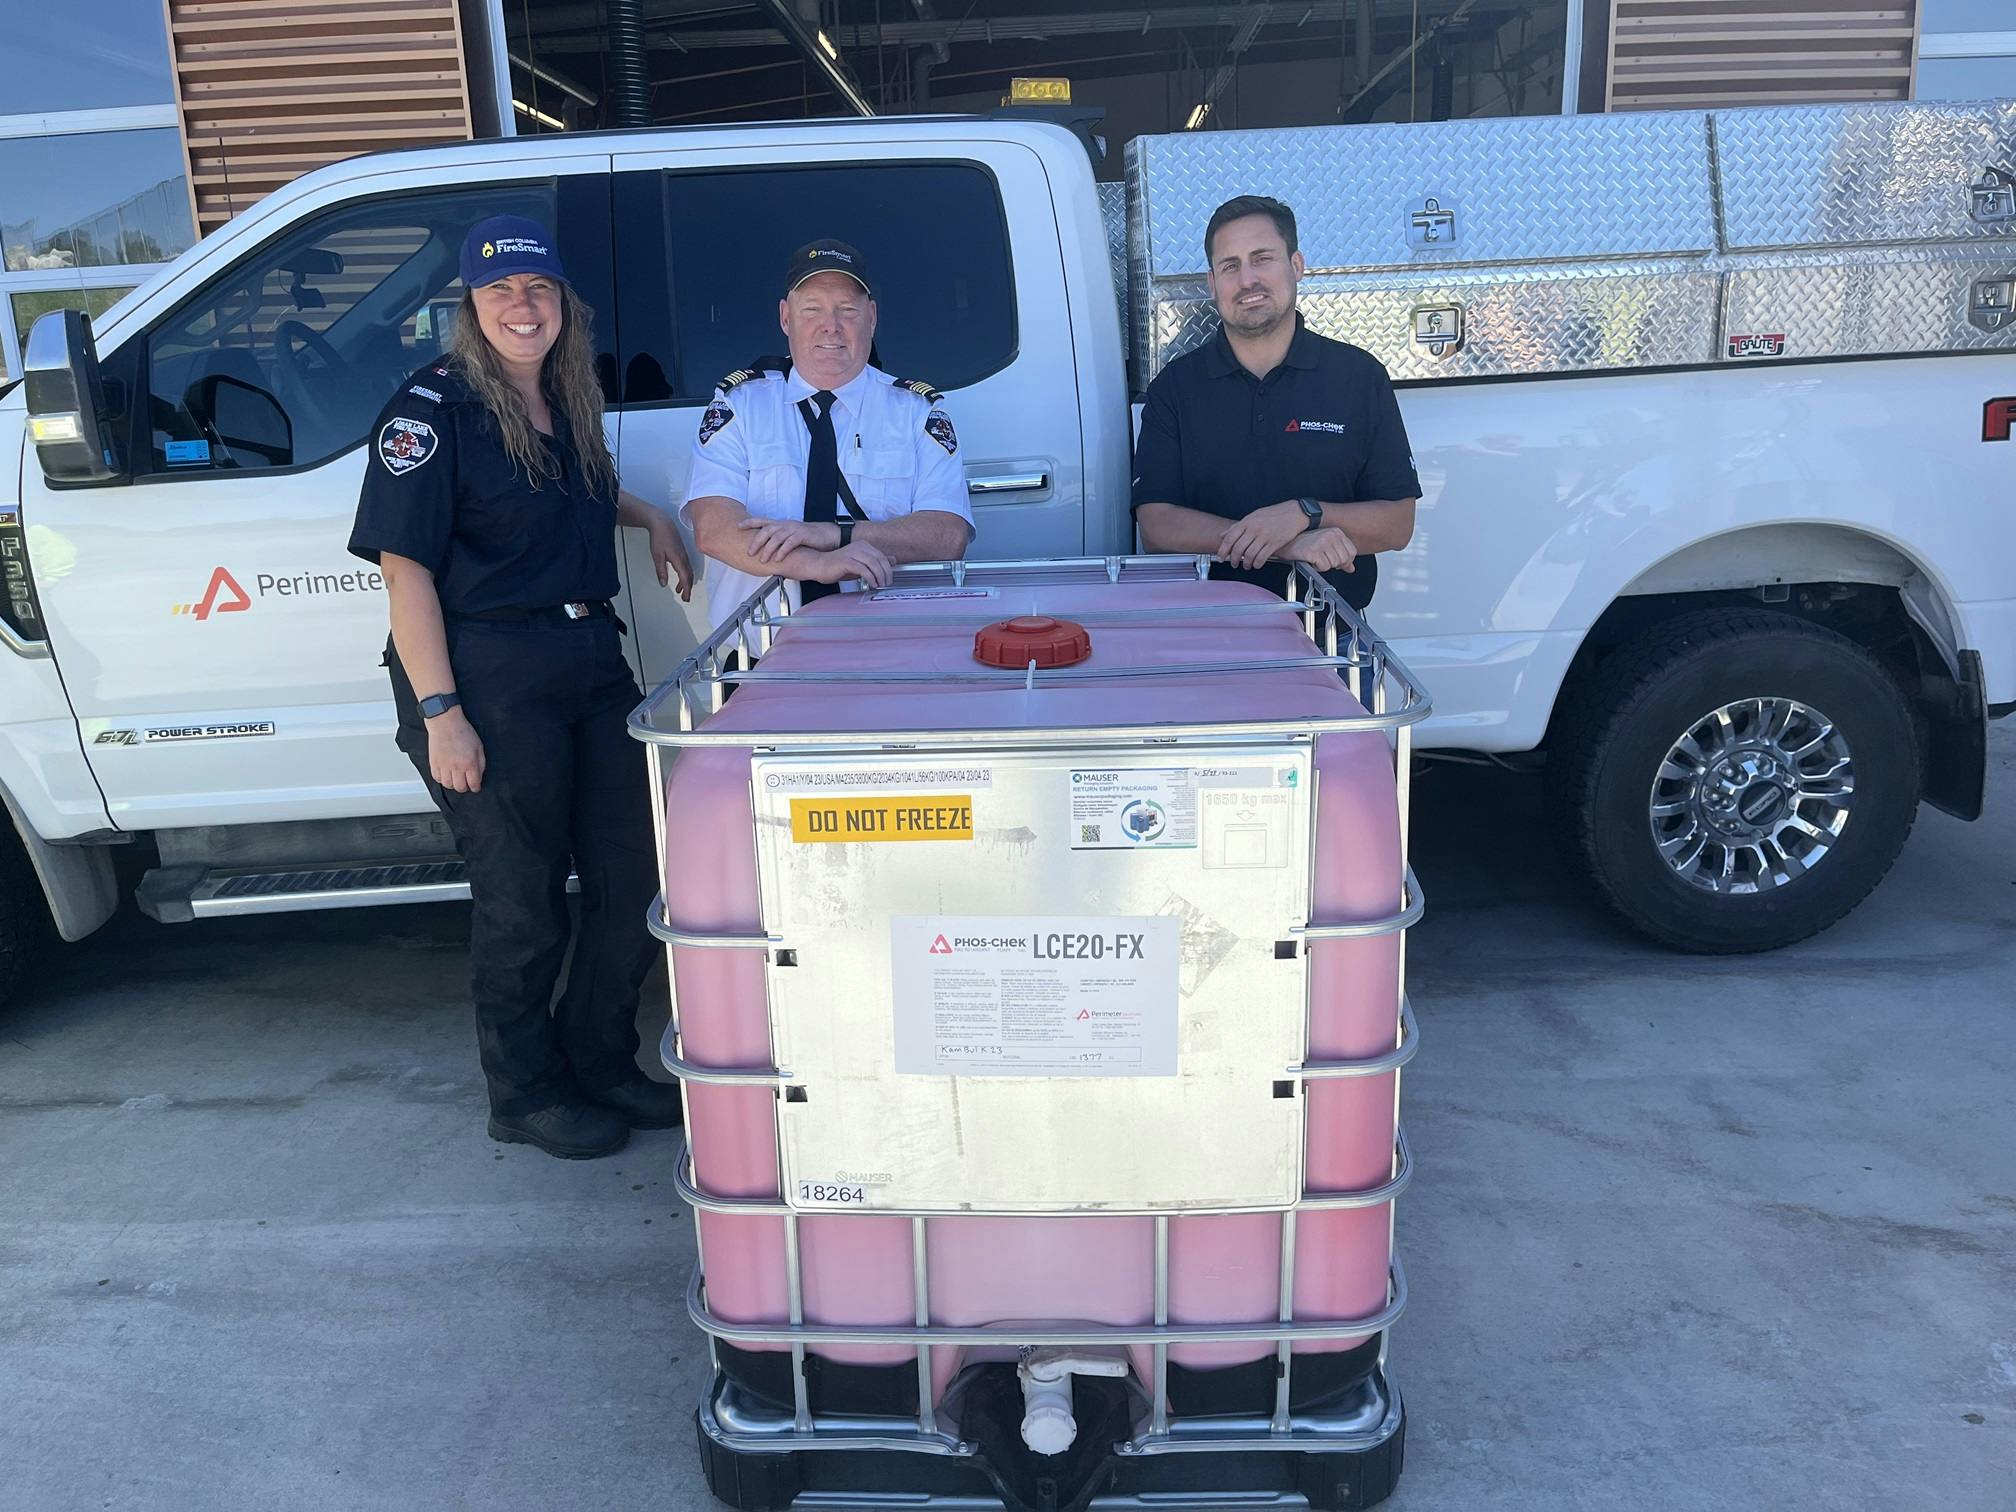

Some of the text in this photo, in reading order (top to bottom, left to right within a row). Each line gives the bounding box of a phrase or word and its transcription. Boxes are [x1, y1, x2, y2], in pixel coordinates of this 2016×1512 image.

[496, 243, 547, 255] FireSmart
[1740, 339, 1774, 350] BRUTE
[257, 570, 390, 597] Perimete
[148, 727, 202, 738] POWER
[206, 723, 269, 735] STROKE
[808, 807, 970, 832] DO NOT FREEZE
[1033, 933, 1144, 959] LCE20-FX
[849, 1173, 893, 1182] MAUSER
[802, 1184, 864, 1203] 18264
